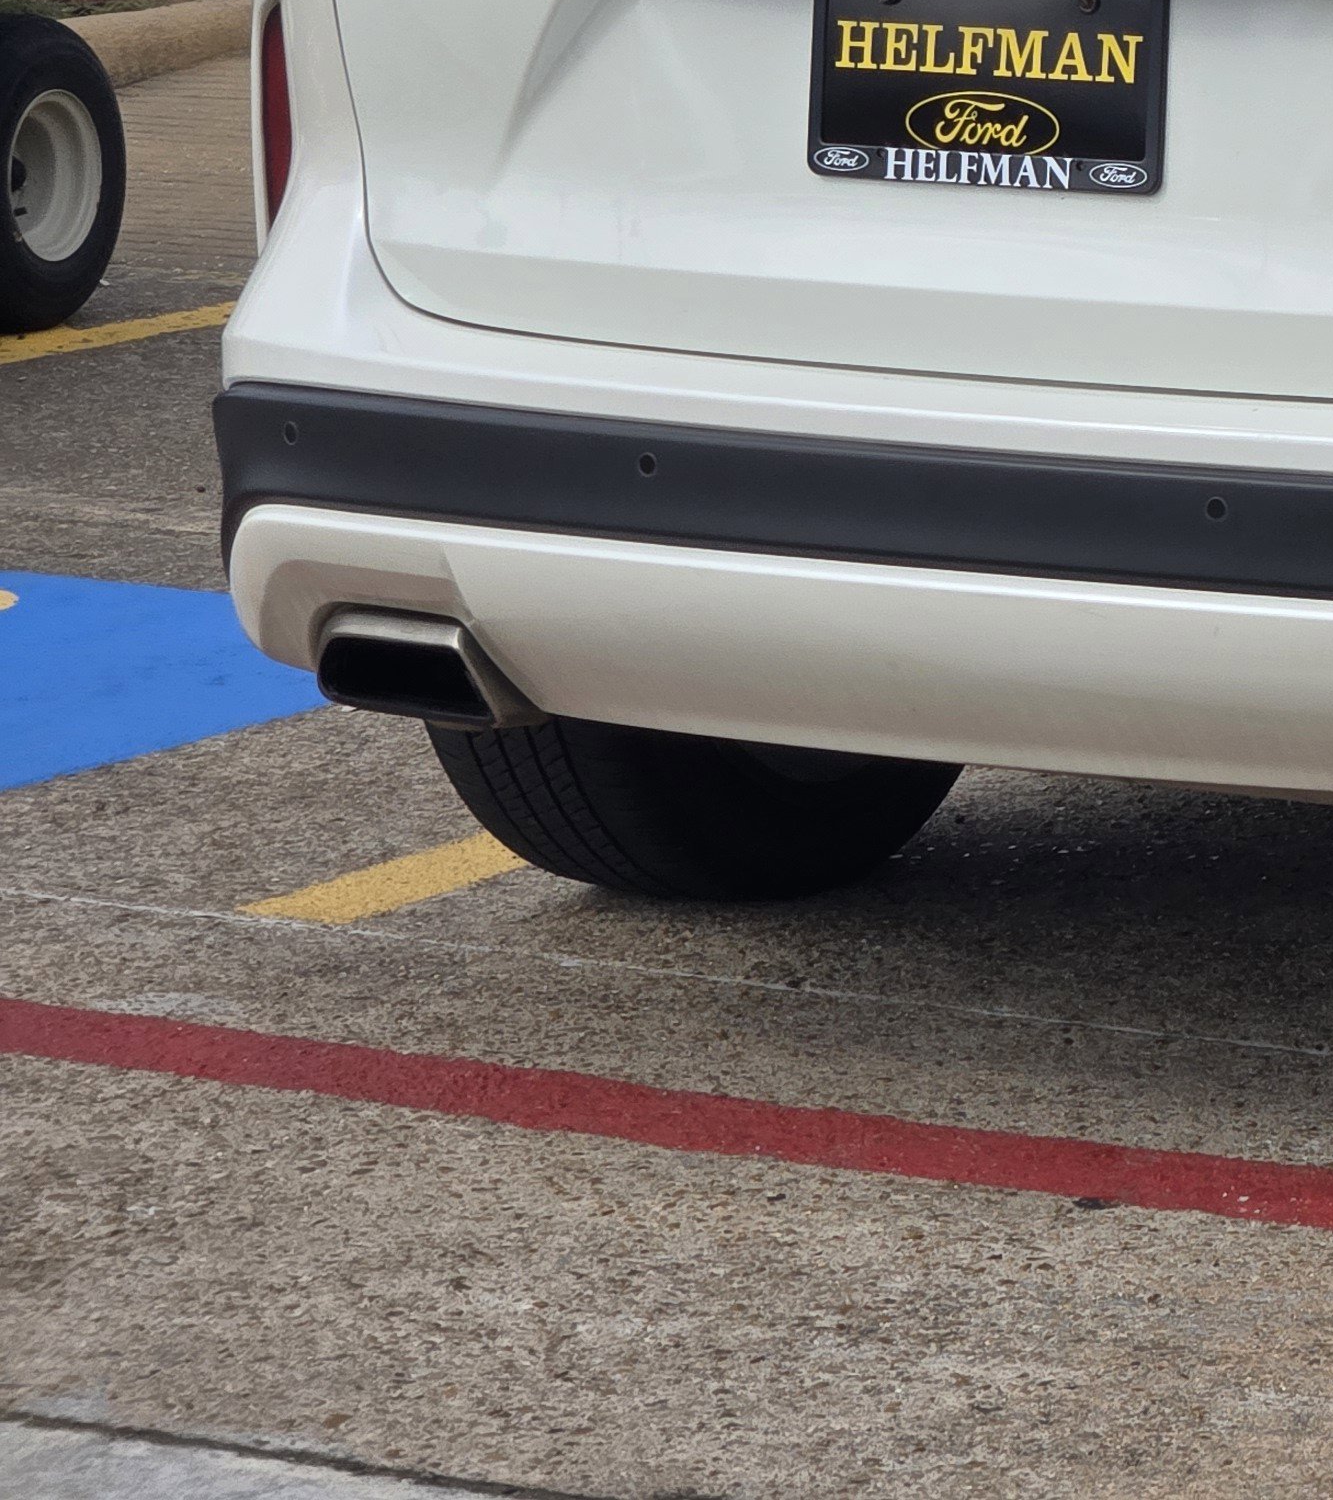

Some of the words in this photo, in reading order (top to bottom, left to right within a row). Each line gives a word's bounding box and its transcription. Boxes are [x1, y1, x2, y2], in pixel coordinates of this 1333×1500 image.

[835, 20, 1144, 85] HELFMAN
[934, 98, 1029, 148] Ford
[823, 150, 859, 169] Ford
[884, 147, 1072, 190] HELFMAN
[1100, 165, 1137, 185] Ford
